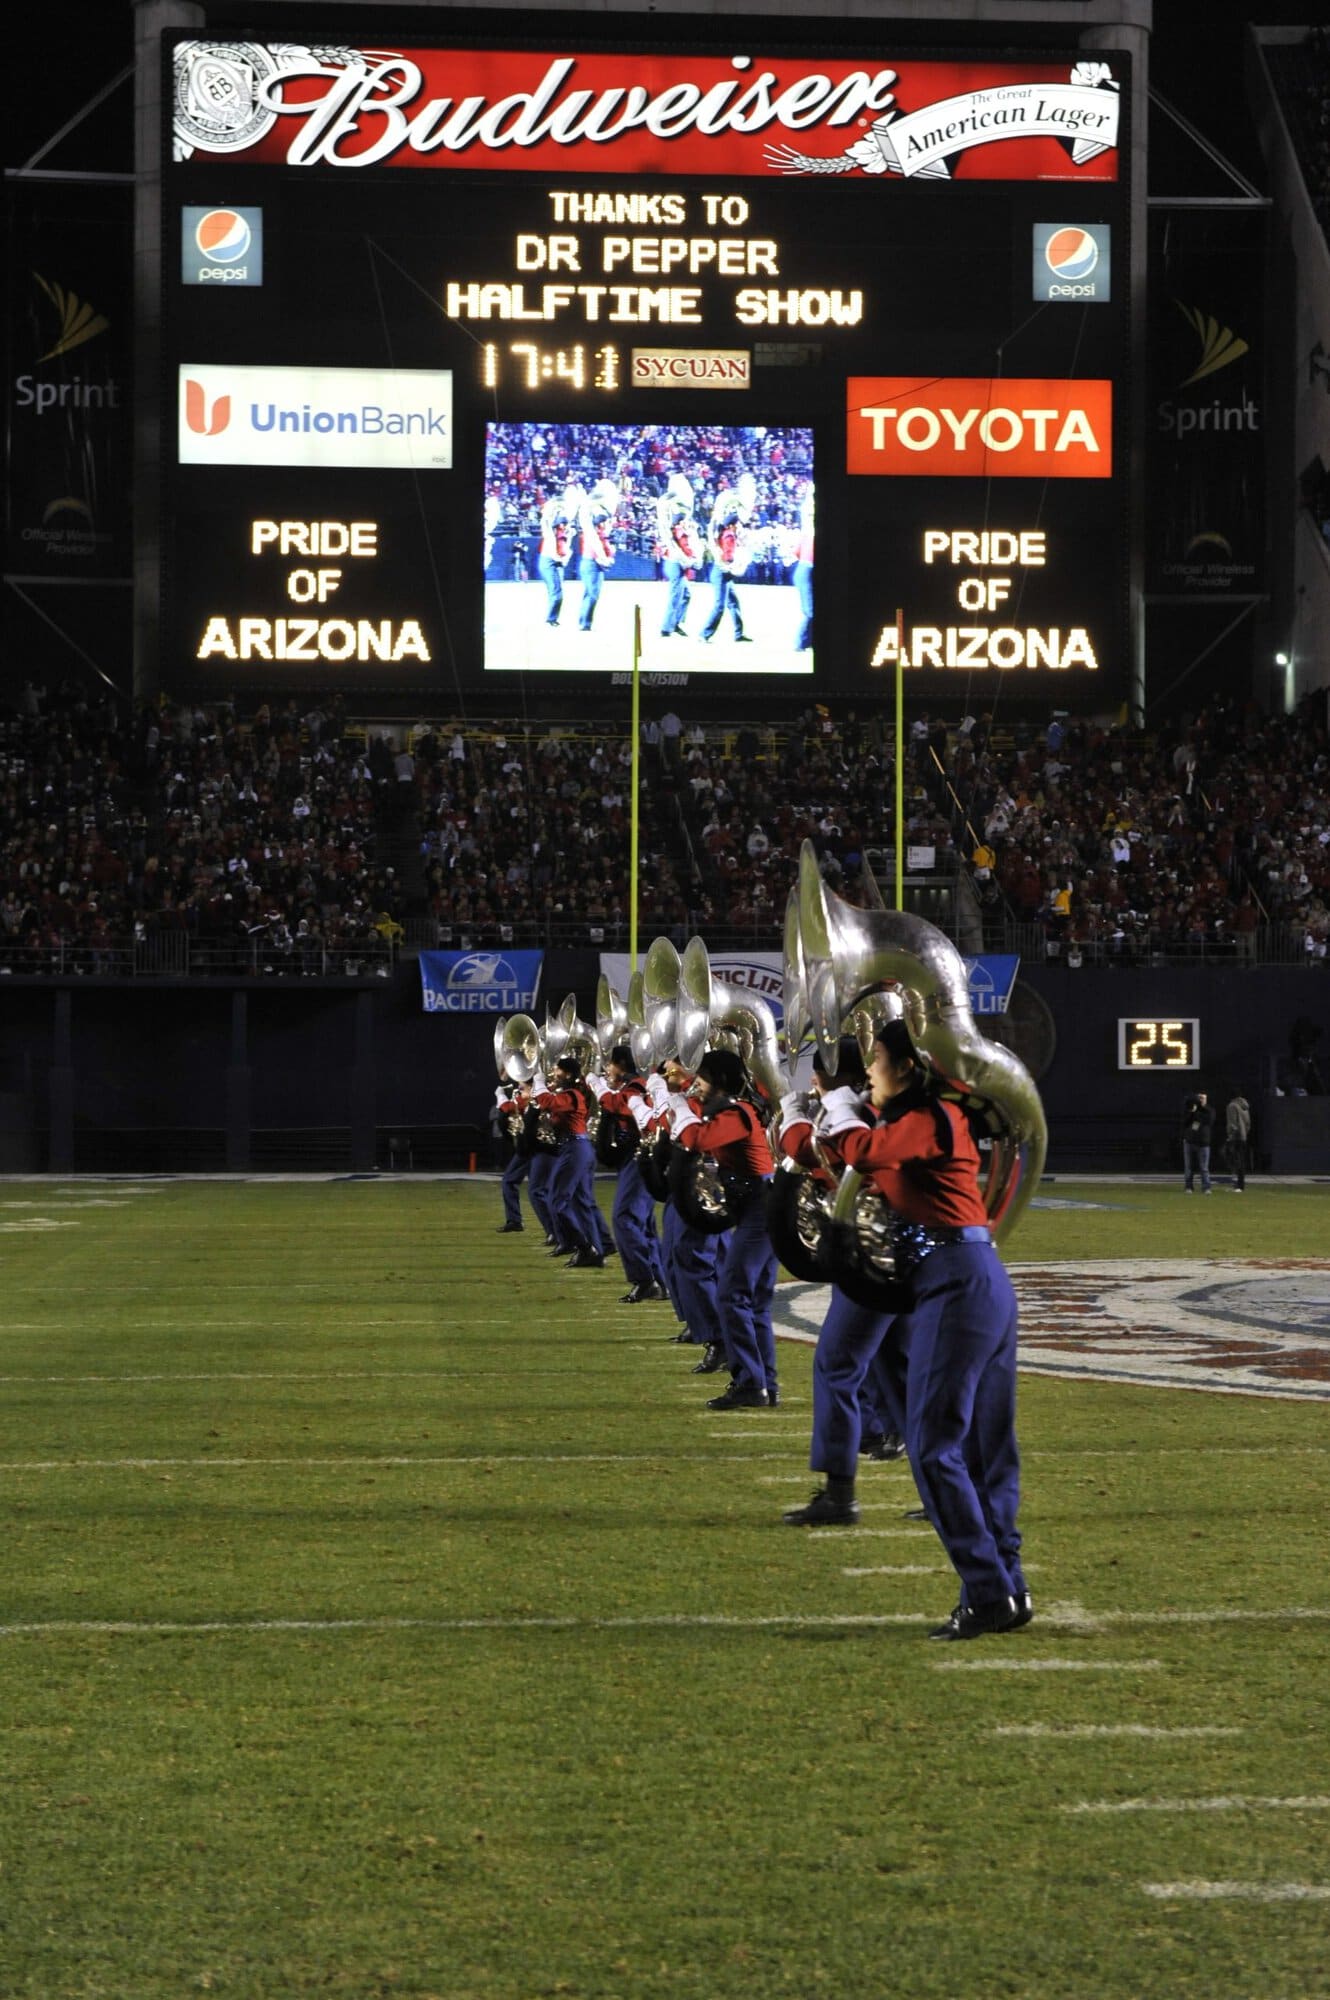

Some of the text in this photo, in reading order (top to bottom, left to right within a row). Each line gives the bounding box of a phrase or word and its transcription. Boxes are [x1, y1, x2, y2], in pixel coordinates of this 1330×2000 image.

[260, 55, 897, 167] Budweiser
[970, 89, 1033, 105] The Great
[907, 101, 1111, 159] American Lager
[549, 192, 749, 225] THANKS TO
[516, 235, 780, 275] DR PEPPER
[198, 266, 248, 282] pepsi
[1048, 283, 1095, 299] pepsi
[446, 282, 863, 325] HALFTIME SHOW
[635, 356, 748, 379] SYCUAN
[15, 374, 120, 415] Sprint
[250, 403, 446, 435] UnionBank
[860, 407, 1100, 452] TOYOTA
[1157, 399, 1260, 440] Sprint
[252, 520, 378, 556] PRIDE
[924, 531, 1046, 565] PRIDE
[287, 569, 342, 602] OF
[958, 578, 1012, 611] OF
[196, 617, 432, 662] ARIZONA
[870, 626, 1099, 669] ARIZONA
[423, 989, 498, 1010] PACIFIC
[1131, 1023, 1187, 1065] 25
